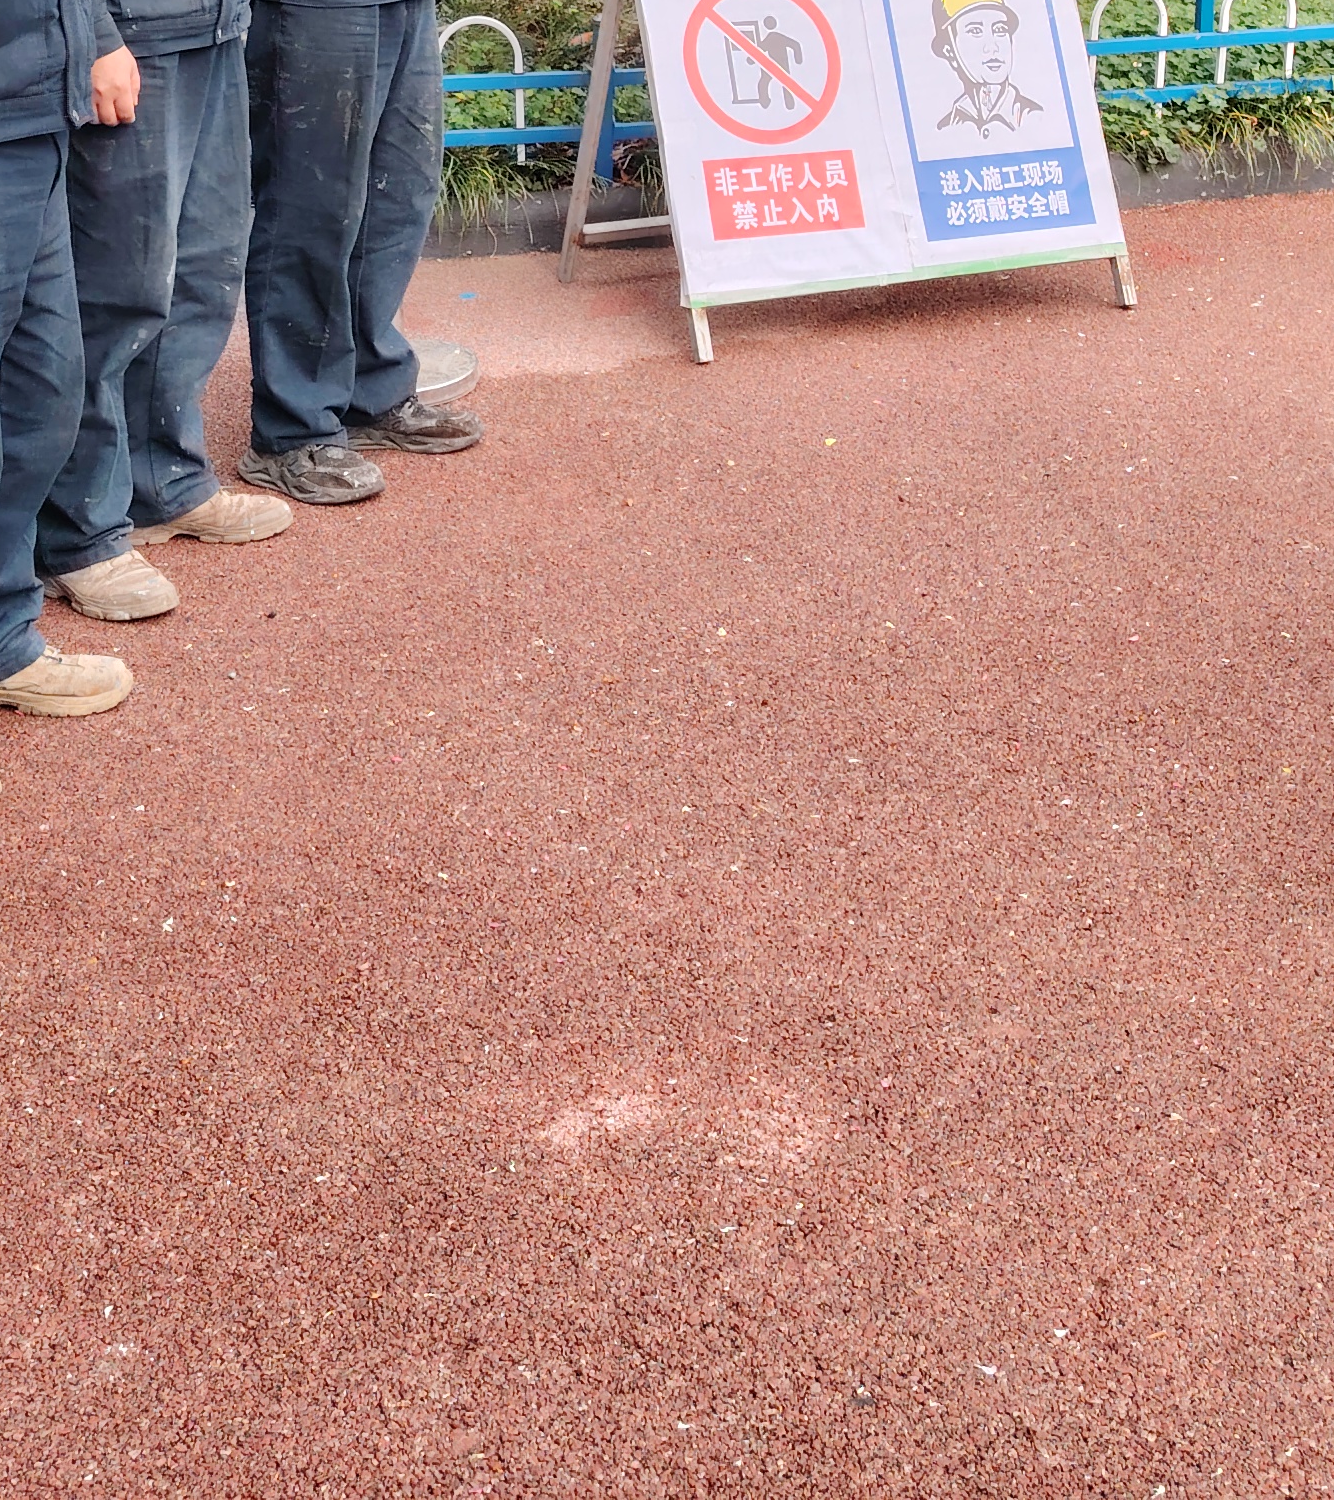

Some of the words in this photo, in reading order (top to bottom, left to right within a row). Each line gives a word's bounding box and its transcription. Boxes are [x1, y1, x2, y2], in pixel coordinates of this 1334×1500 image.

[713, 159, 849, 197] 非工作人员
[939, 160, 1064, 195] 进入施工现场
[732, 193, 840, 230] 禁止入内
[946, 189, 1070, 226] 必须戴安全帽
